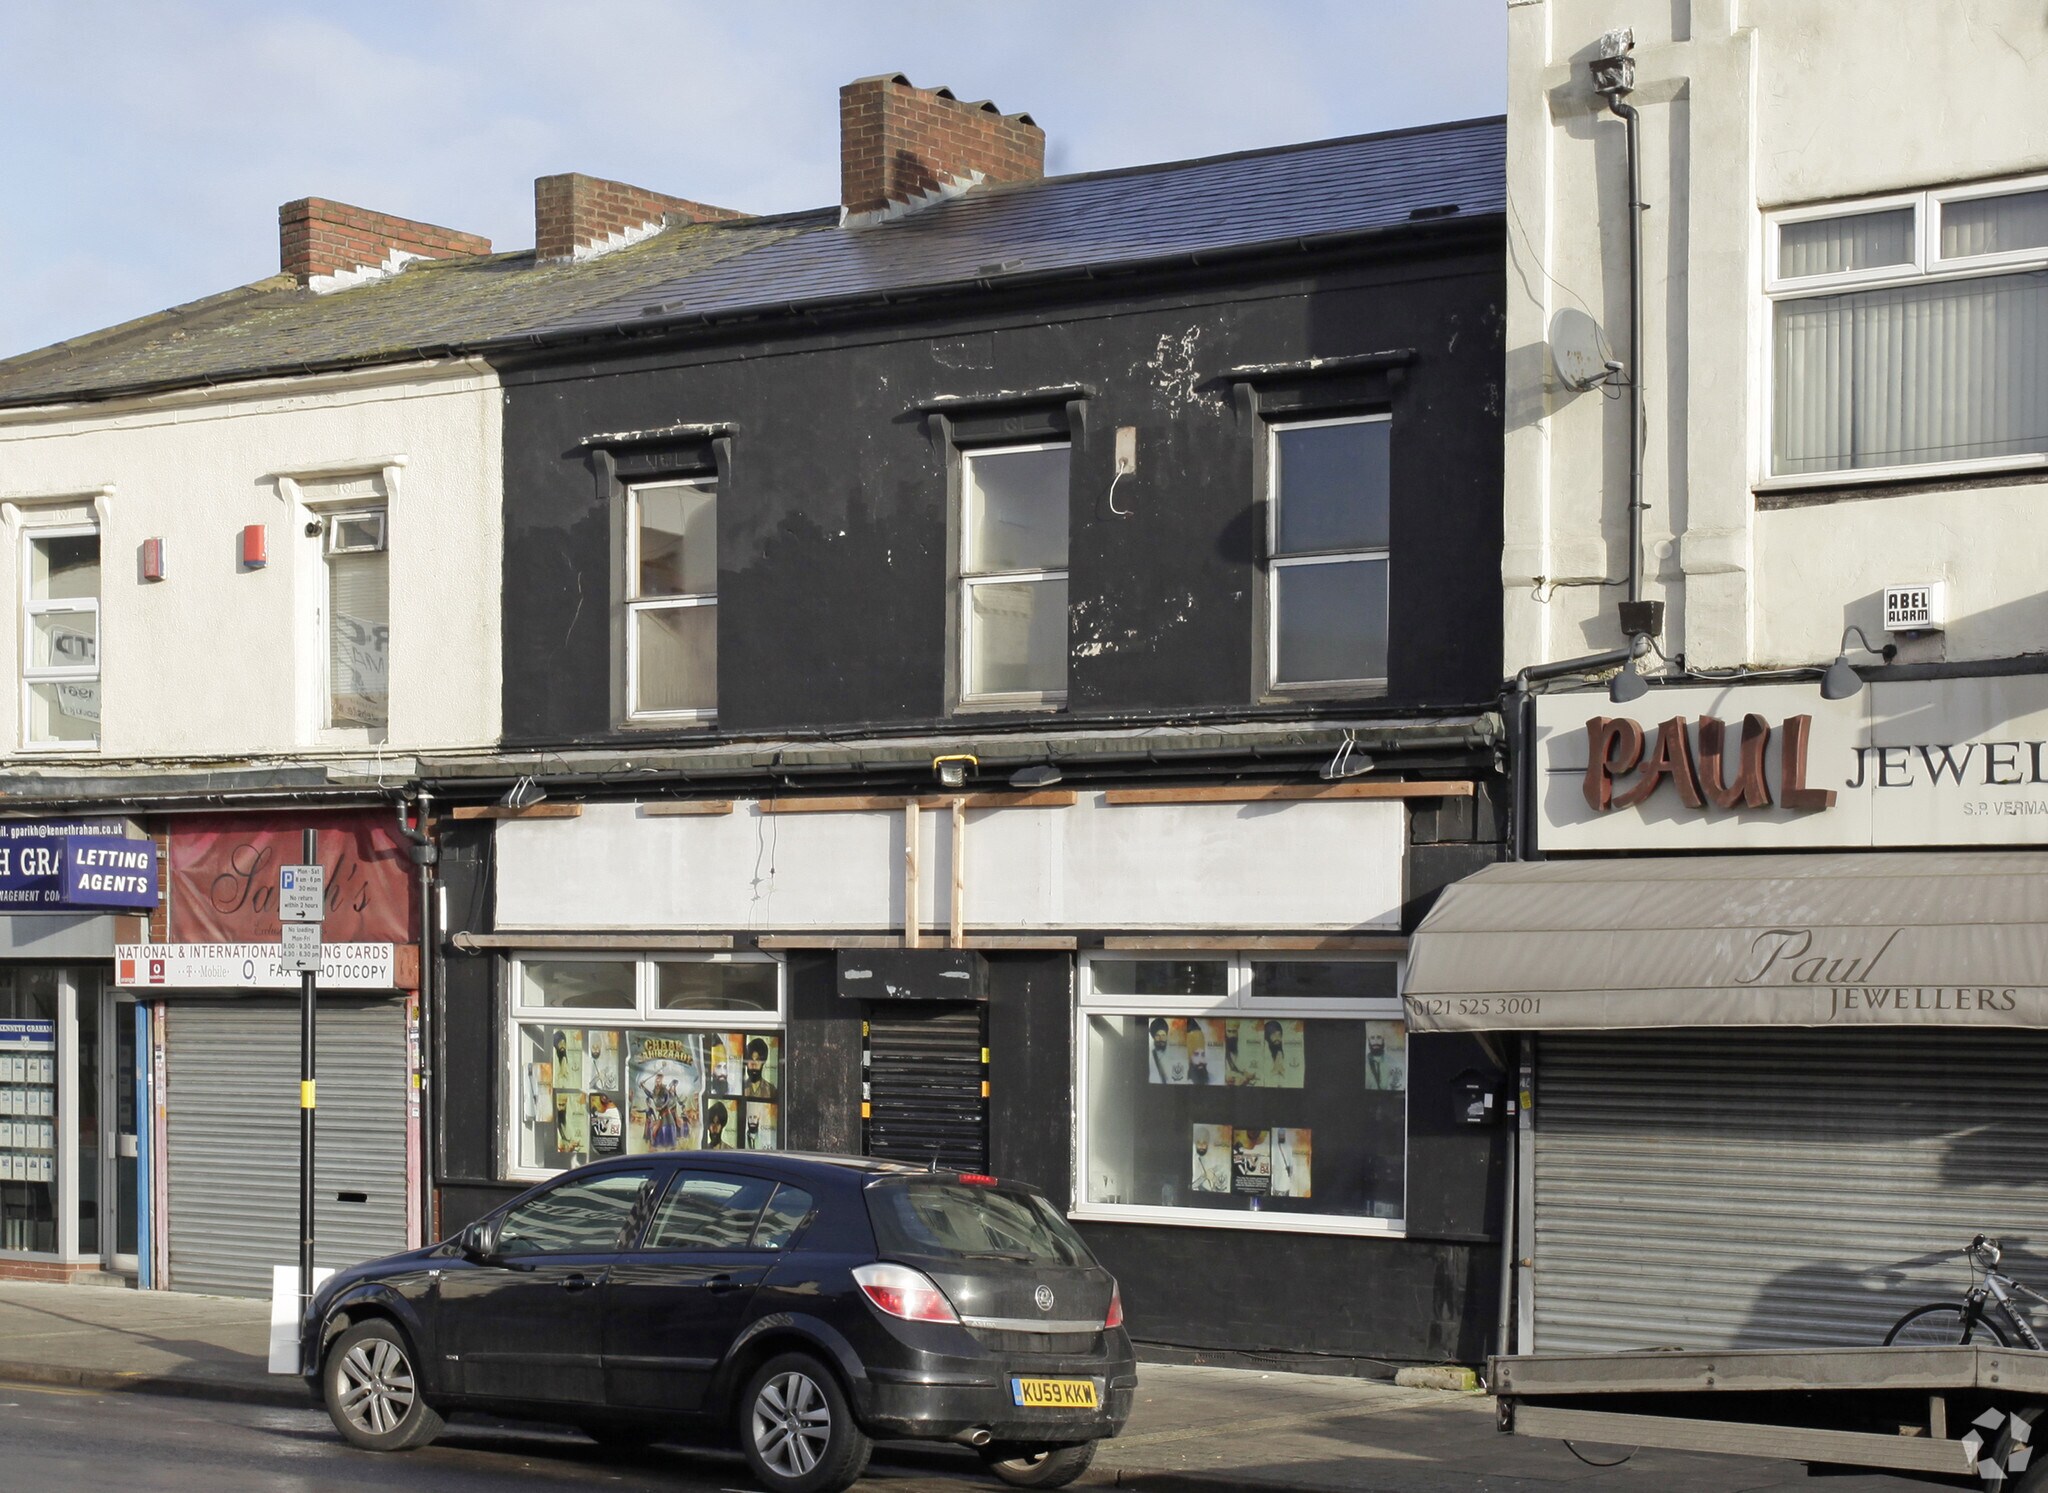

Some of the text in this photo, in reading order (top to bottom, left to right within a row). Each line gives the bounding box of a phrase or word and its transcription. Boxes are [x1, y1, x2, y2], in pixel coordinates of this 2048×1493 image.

[1888, 592, 1928, 610] ABEL
[1888, 609, 1928, 623] ALARM
[1583, 713, 1838, 811] PAUL
[1963, 801, 1989, 816] S.P.
[76, 848, 149, 870] LETTING
[78, 873, 148, 894] AGENTS
[210, 844, 371, 914] Sah's
[297, 926, 315, 934] loading
[118, 946, 174, 959] NATIONAL
[178, 945, 185, 958] &
[189, 945, 283, 959] INTERNATIONAL
[346, 945, 389, 959] CARDS
[1735, 927, 1905, 984] Paul
[317, 964, 387, 979] HOTOCOPY
[1413, 998, 1541, 1016] 0121 525 3001
[1828, 987, 2017, 1022] JEWELLERS
[1022, 1382, 1093, 1404] KU59 KKW
